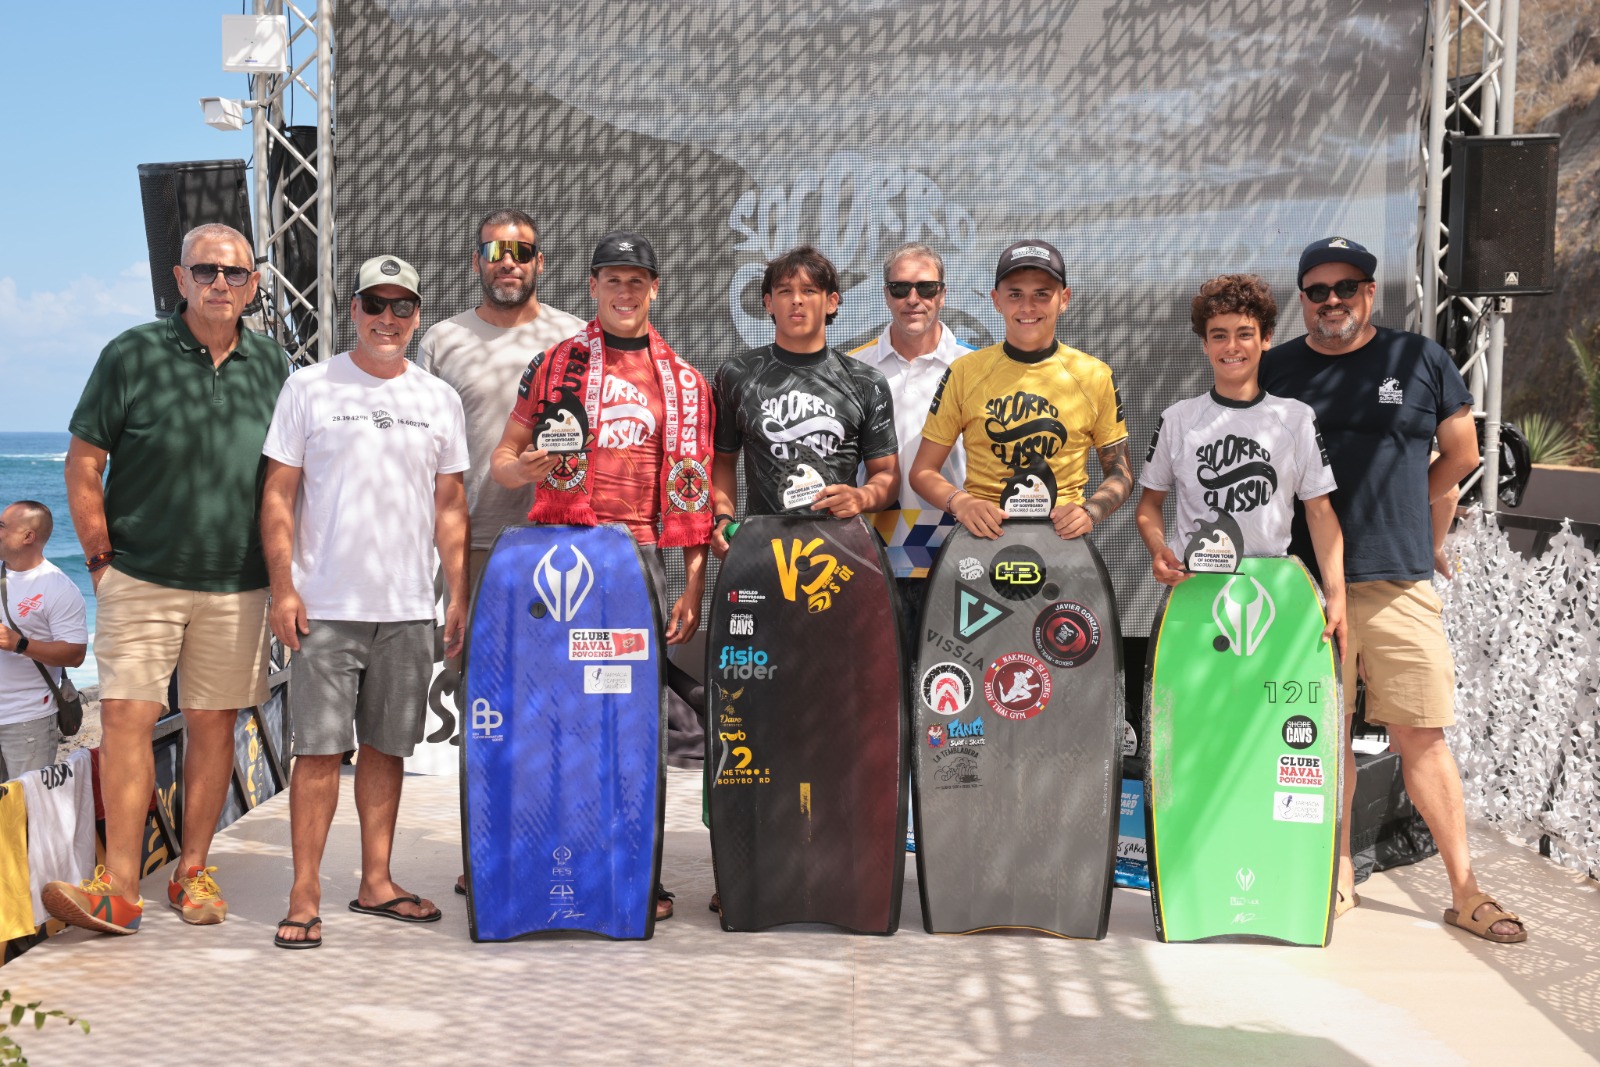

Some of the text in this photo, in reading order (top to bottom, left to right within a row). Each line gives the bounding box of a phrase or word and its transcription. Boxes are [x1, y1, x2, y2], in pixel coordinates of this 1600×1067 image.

[603, 374, 649, 408] ORRO
[761, 390, 836, 426] SOCORRO
[985, 391, 1059, 426] SOCORRO
[1195, 434, 1271, 472] SOCORRO
[787, 486, 810, 496] EUROPEAN
[1203, 480, 1271, 514] CLASSIC
[730, 619, 754, 636] CAVS
[1055, 603, 1100, 646] JAVIER GONZÁLEZ
[572, 631, 610, 641] CLUBE
[572, 641, 613, 651] NAVAL
[719, 645, 769, 670] fisio
[926, 628, 985, 673] VISSLA
[723, 661, 778, 681] rider
[1002, 653, 1038, 666] NAKMUAY
[1041, 672, 1052, 699] DAENG
[984, 681, 1027, 720] MUAY THAI GYM
[1286, 720, 1312, 728] SHORE
[1286, 727, 1313, 744] CAVS
[732, 746, 753, 769] 2
[932, 746, 980, 764] LA TEMBLADERA
[1280, 755, 1320, 768] CLUBE
[1279, 765, 1323, 778] NAVAL
[1279, 776, 1323, 786] POVOENSE
